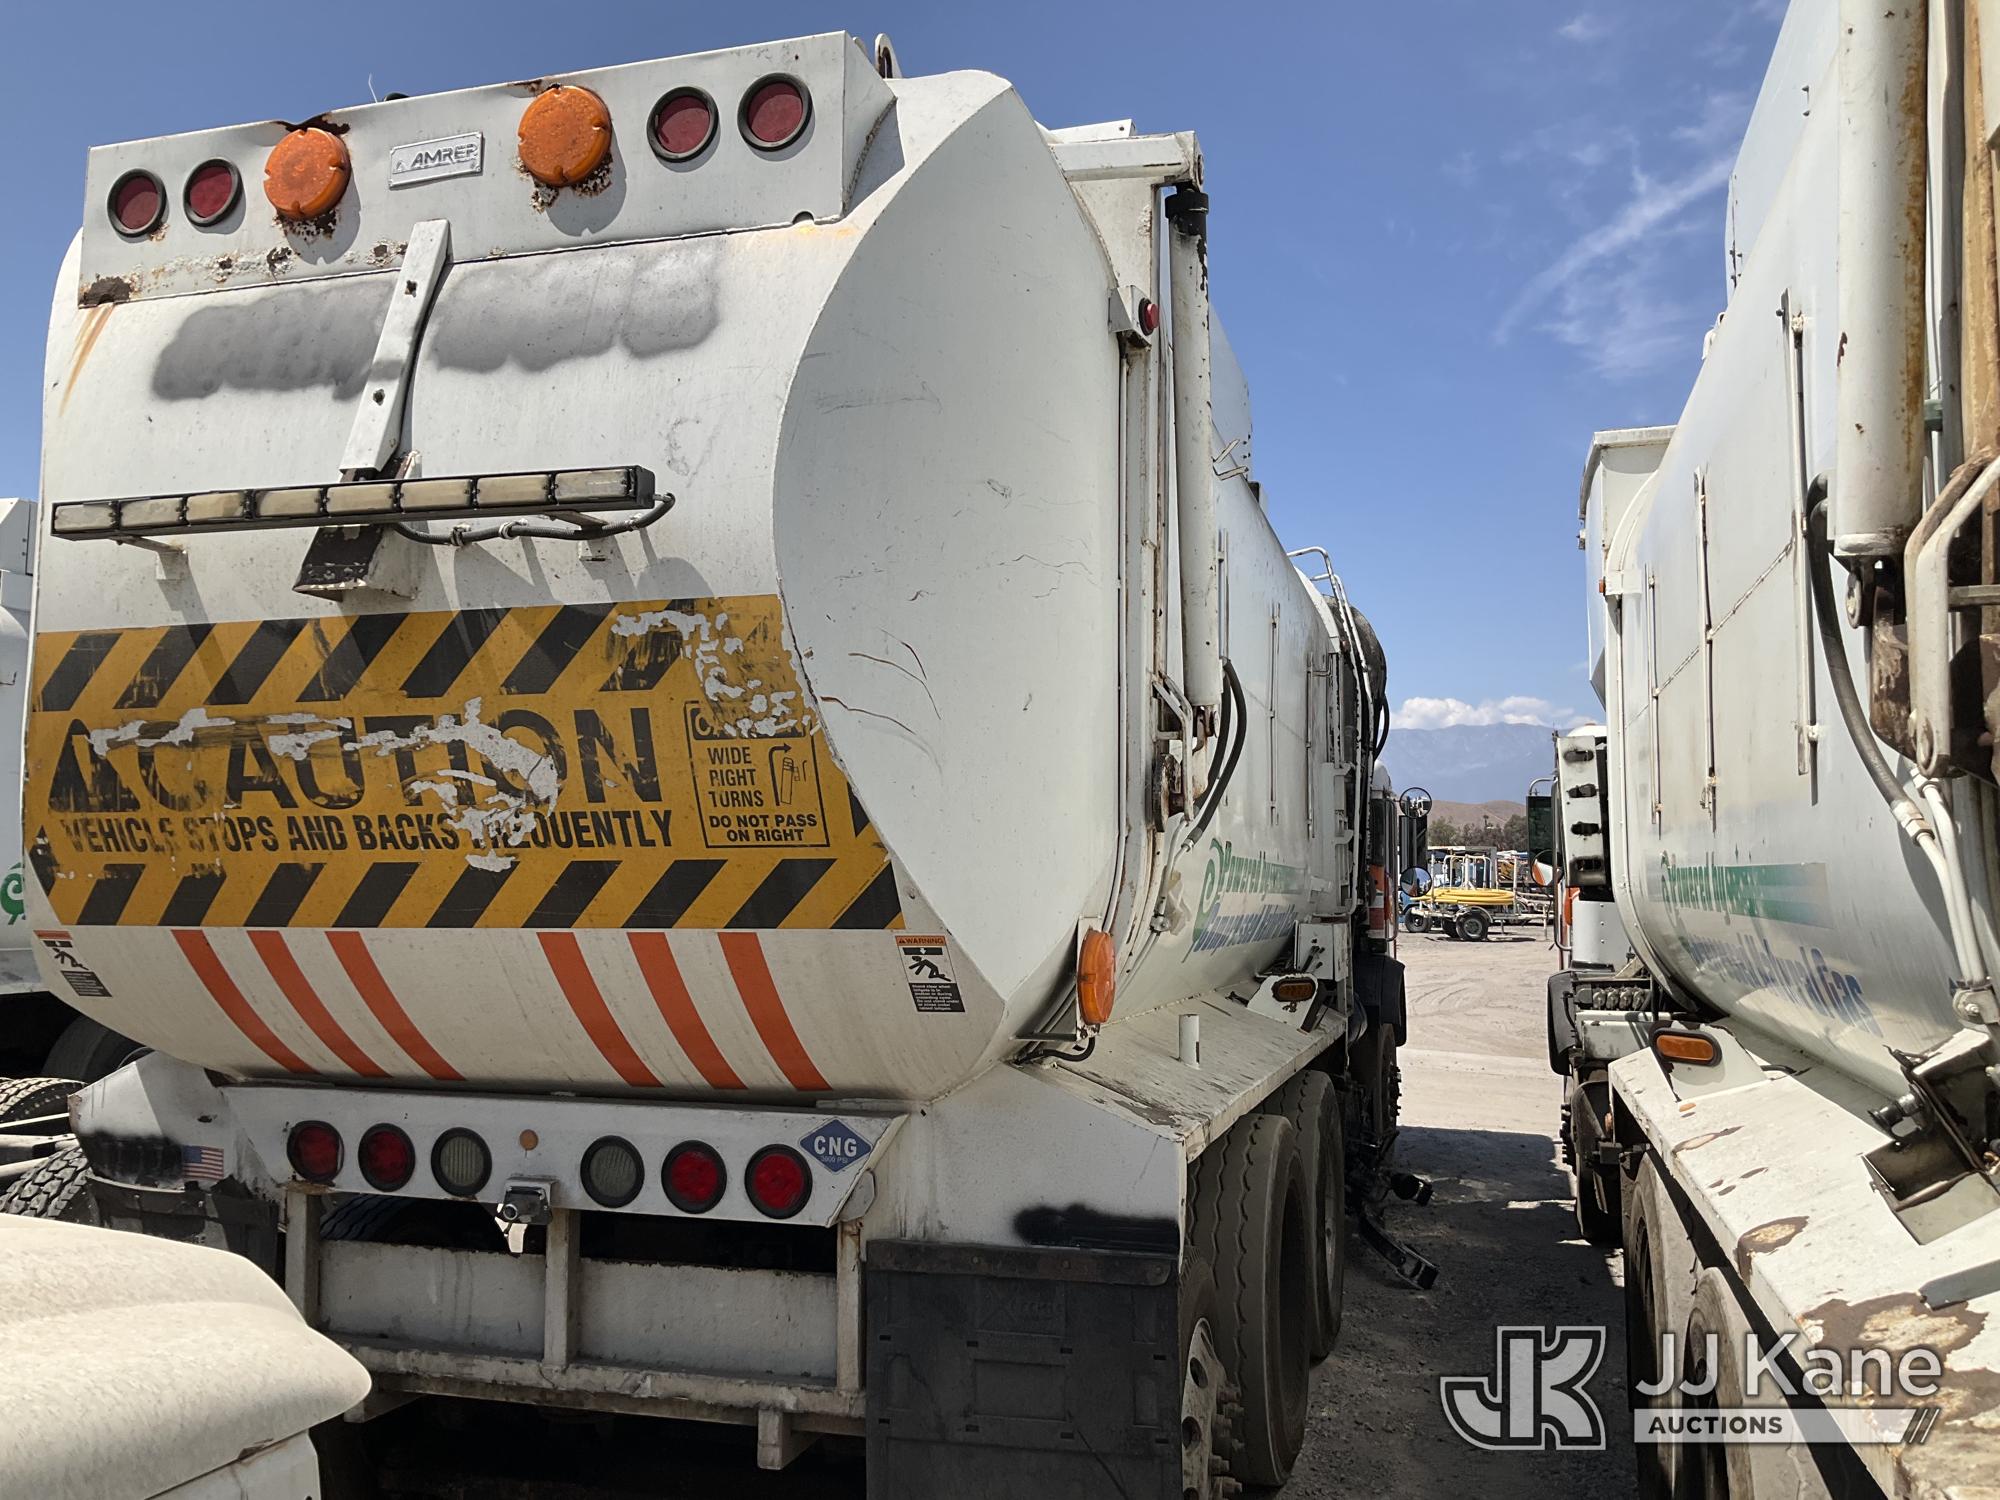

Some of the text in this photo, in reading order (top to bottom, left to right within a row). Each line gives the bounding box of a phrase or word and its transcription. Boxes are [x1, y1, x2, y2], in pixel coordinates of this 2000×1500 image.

[411, 143, 478, 167] AMREP
[136, 708, 663, 812] CAUTION
[706, 747, 753, 765] WIDE
[709, 769, 756, 786] RIGHT
[708, 790, 765, 808] TURNS
[709, 814, 818, 828] DO NOT PASS
[60, 808, 673, 853] VEHICLE STOPS AND BACKS QUENTLY
[726, 828, 805, 842] ON RIGHT
[813, 1135, 857, 1157] CNG
